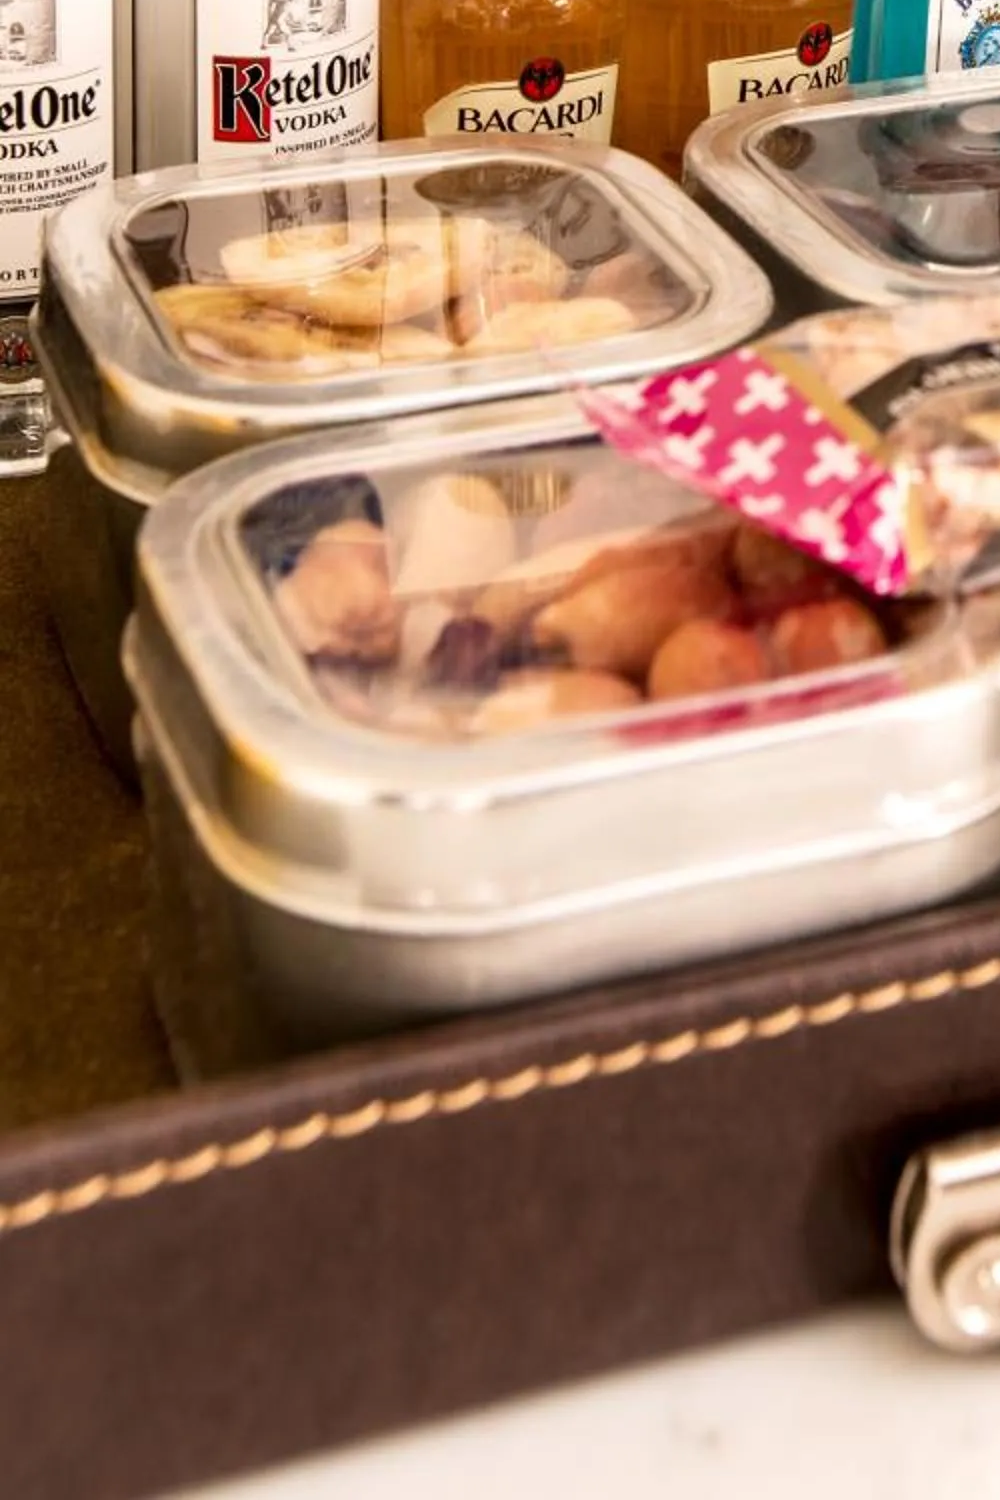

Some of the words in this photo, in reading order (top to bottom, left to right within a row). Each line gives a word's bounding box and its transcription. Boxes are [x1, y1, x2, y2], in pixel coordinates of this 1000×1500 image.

[215, 62, 323, 140] Ketel
[326, 51, 372, 97] One
[737, 56, 850, 103] BACARD
[31, 85, 97, 130] One
[274, 105, 348, 134] VODKA
[456, 91, 603, 134] BACARDI
[54, 157, 88, 176] SMALL
[274, 138, 327, 155] INSPIRED
